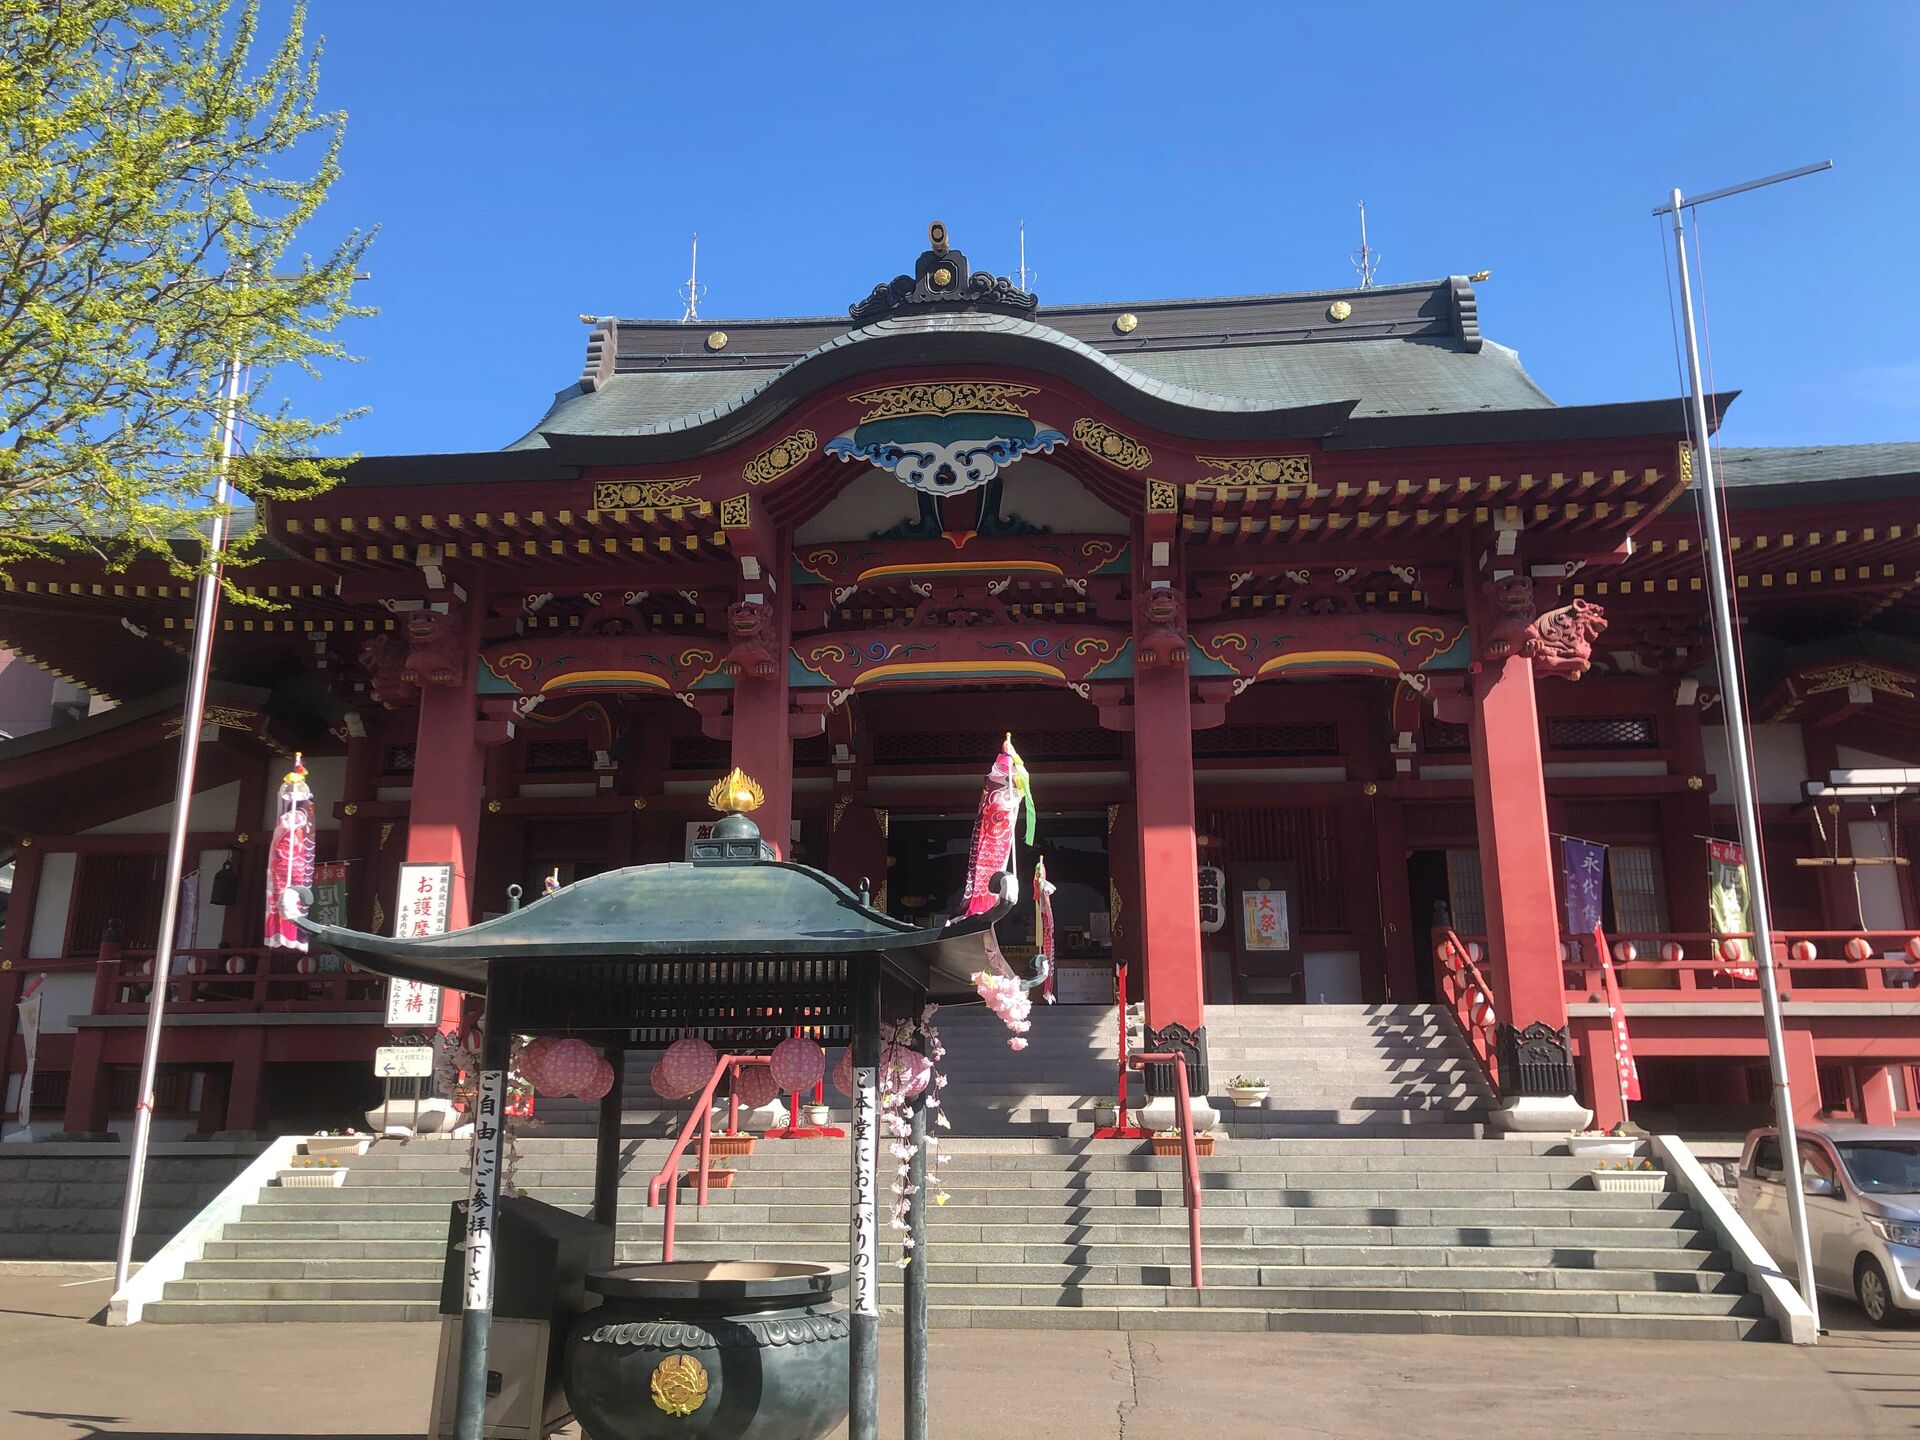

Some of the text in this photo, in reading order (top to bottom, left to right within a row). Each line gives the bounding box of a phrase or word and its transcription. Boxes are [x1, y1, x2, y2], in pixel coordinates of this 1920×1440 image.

[411, 876, 434, 937] お護摩
[1258, 895, 1276, 932] 大祭
[467, 1072, 500, 1307] ご自由にご参拝下さい
[852, 1069, 873, 1312] ご本堂にお上がりのうえ
